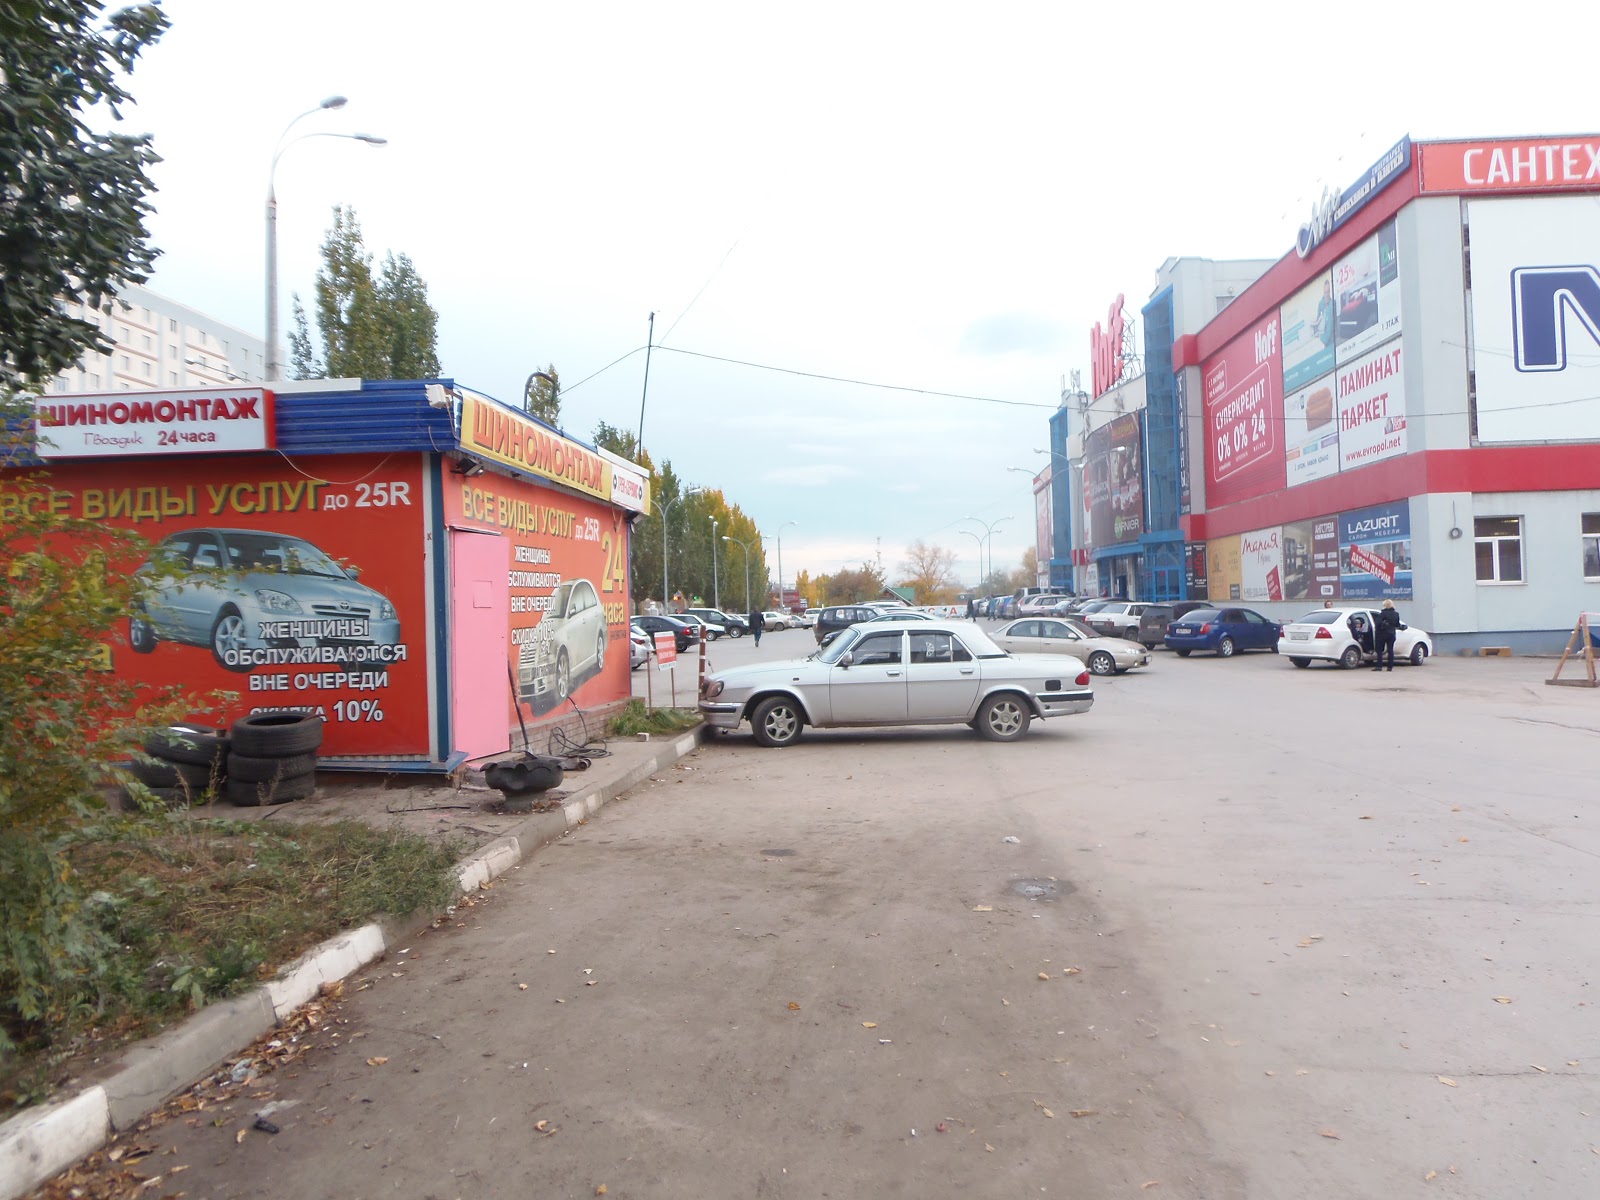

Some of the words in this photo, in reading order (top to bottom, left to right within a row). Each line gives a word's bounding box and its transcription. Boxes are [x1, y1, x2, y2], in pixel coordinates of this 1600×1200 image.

[1340, 348, 1401, 398] ЛАМИНАТ
[40, 396, 260, 427] ШИНОМОНТАЖ
[1215, 378, 1265, 430] СУПЕРКРЕДИТ
[1341, 392, 1389, 432] ПАРКЕТ
[83, 430, 144, 446] Гвоздик
[157, 430, 179, 446] 24
[181, 430, 216, 444] часа
[473, 400, 603, 493] ШИНОМОНТАЖ
[1217, 432, 1231, 462] 0%
[1233, 420, 1248, 452] 0%
[1251, 408, 1266, 442] 24
[1345, 436, 1401, 462] www.evropol.net
[82, 484, 197, 524] ВИДЫ
[206, 479, 331, 515] УСЛУГ
[323, 494, 348, 510] до
[355, 480, 412, 508] 25R
[462, 485, 495, 524] ВСЕ
[498, 495, 539, 538] ВИДЫ
[542, 506, 576, 540] УСЛУГ
[575, 524, 583, 540] до
[584, 517, 600, 542] 25R
[1347, 515, 1399, 534] LAZURIT
[1348, 533, 1368, 541] САЛОН
[1374, 529, 1400, 537] МЕБЕЛИ
[515, 545, 550, 565] ЖЕНЩИНЫ
[602, 532, 624, 594] 24
[1351, 552, 1371, 572] ДАРОМ
[1370, 564, 1391, 585] ДАРИМ
[511, 596, 526, 612] ВНЕ
[527, 596, 556, 613] ОЧЕРЕДИ
[258, 619, 370, 640] ЖЕНЩИНЫ
[224, 643, 407, 667] ОБСЛУЖИВАЮТСЯ
[249, 673, 290, 692] ВНЕ
[294, 671, 389, 691] ОЧЕРЕДИ
[333, 699, 384, 723] 10%
